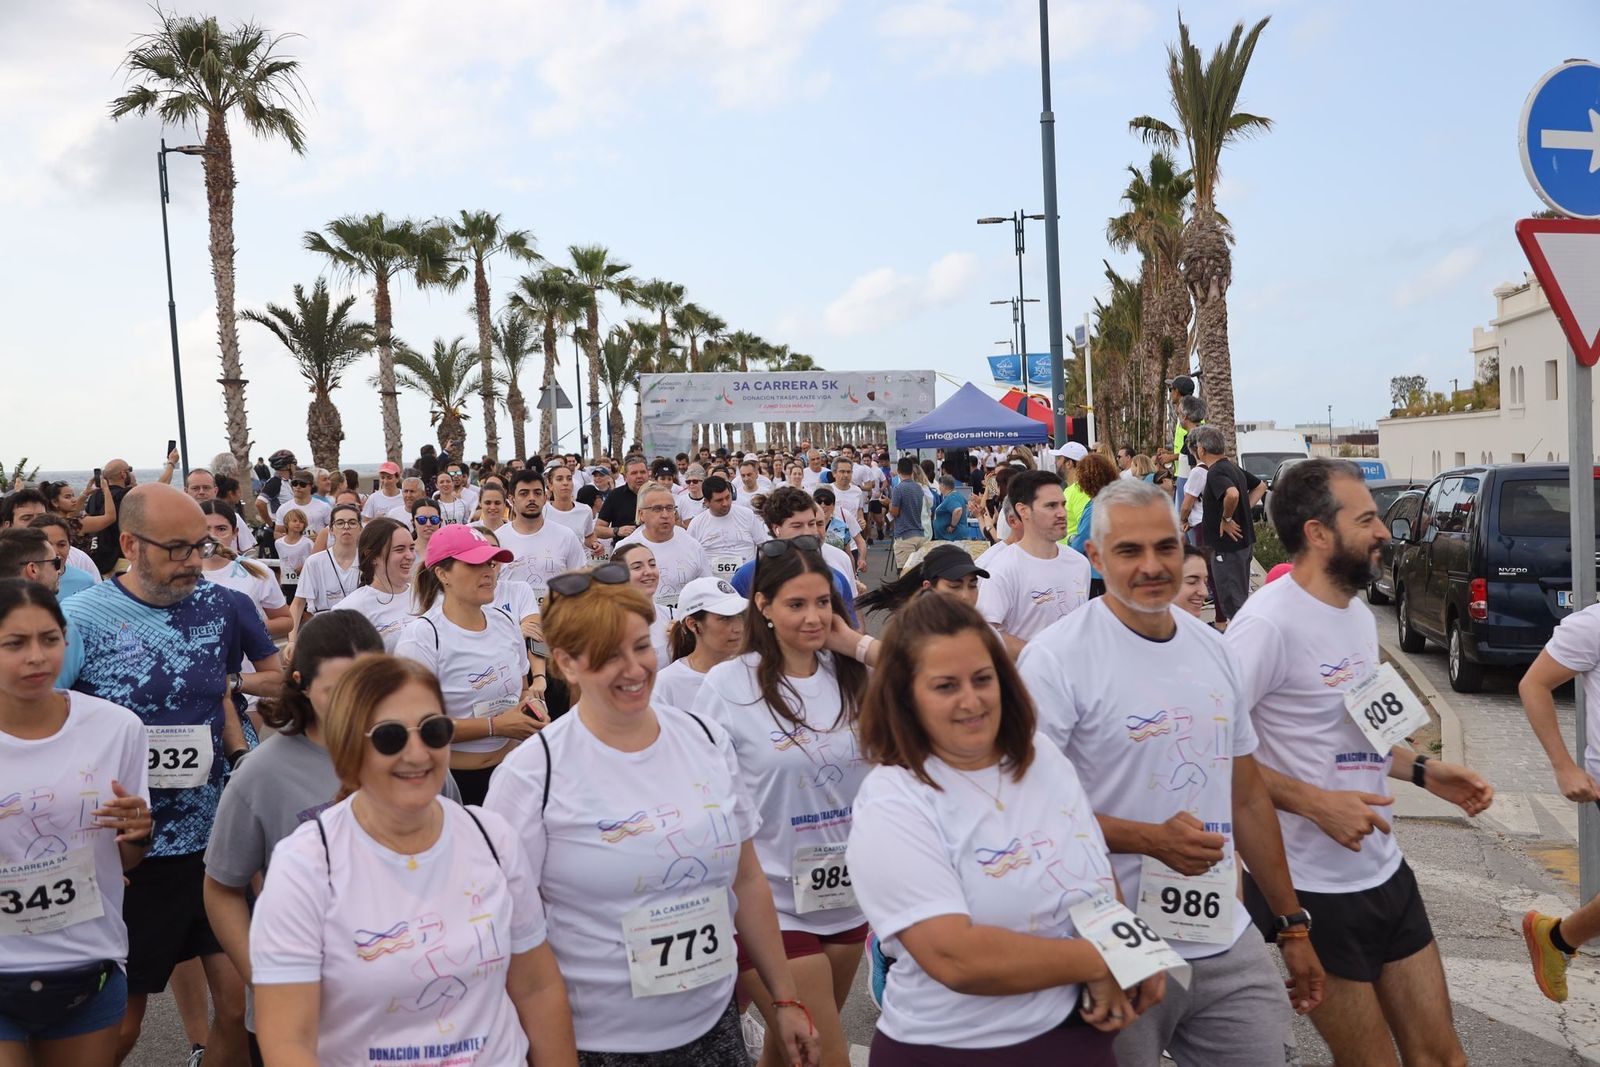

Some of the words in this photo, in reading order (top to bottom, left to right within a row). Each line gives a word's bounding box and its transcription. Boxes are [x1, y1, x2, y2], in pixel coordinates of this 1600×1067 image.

[733, 381, 751, 391] 3A
[754, 380, 818, 391] CARRERA
[821, 380, 839, 390] 5K
[925, 431, 1019, 441] info@dorsalchip.es
[717, 563, 738, 572] 567
[148, 747, 199, 770] 932
[10, 859, 55, 873] CARRERA
[811, 864, 852, 891] 985
[0, 878, 77, 915] 343
[1160, 886, 1221, 919] 986
[663, 898, 701, 914] CARRERA
[650, 923, 719, 967] 773
[369, 1045, 420, 1061] DONACIÓN
